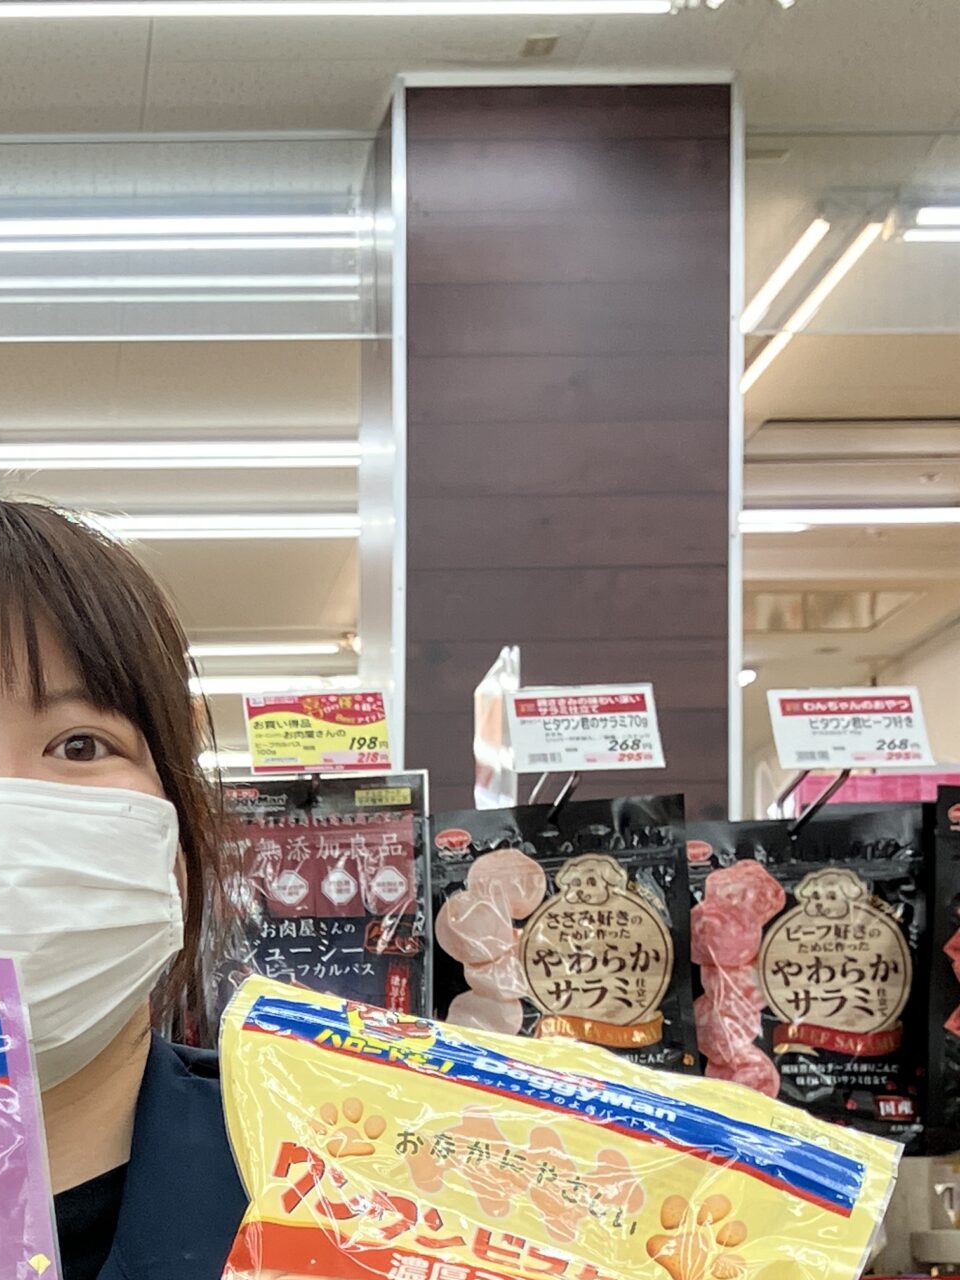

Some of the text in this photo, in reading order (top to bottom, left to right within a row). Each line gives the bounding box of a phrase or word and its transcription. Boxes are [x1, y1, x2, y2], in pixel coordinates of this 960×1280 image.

[253, 719, 312, 729] お買い得品
[256, 833, 407, 861] 無添加良品
[261, 919, 355, 939] お肉屋さんの
[546, 910, 643, 930] ささみ好きの
[785, 923, 881, 944] ビーフ好きの
[533, 943, 661, 978] やわらか
[771, 953, 899, 987] やわらか
[547, 978, 633, 1012] サラミ
[788, 987, 875, 1018] サラミ
